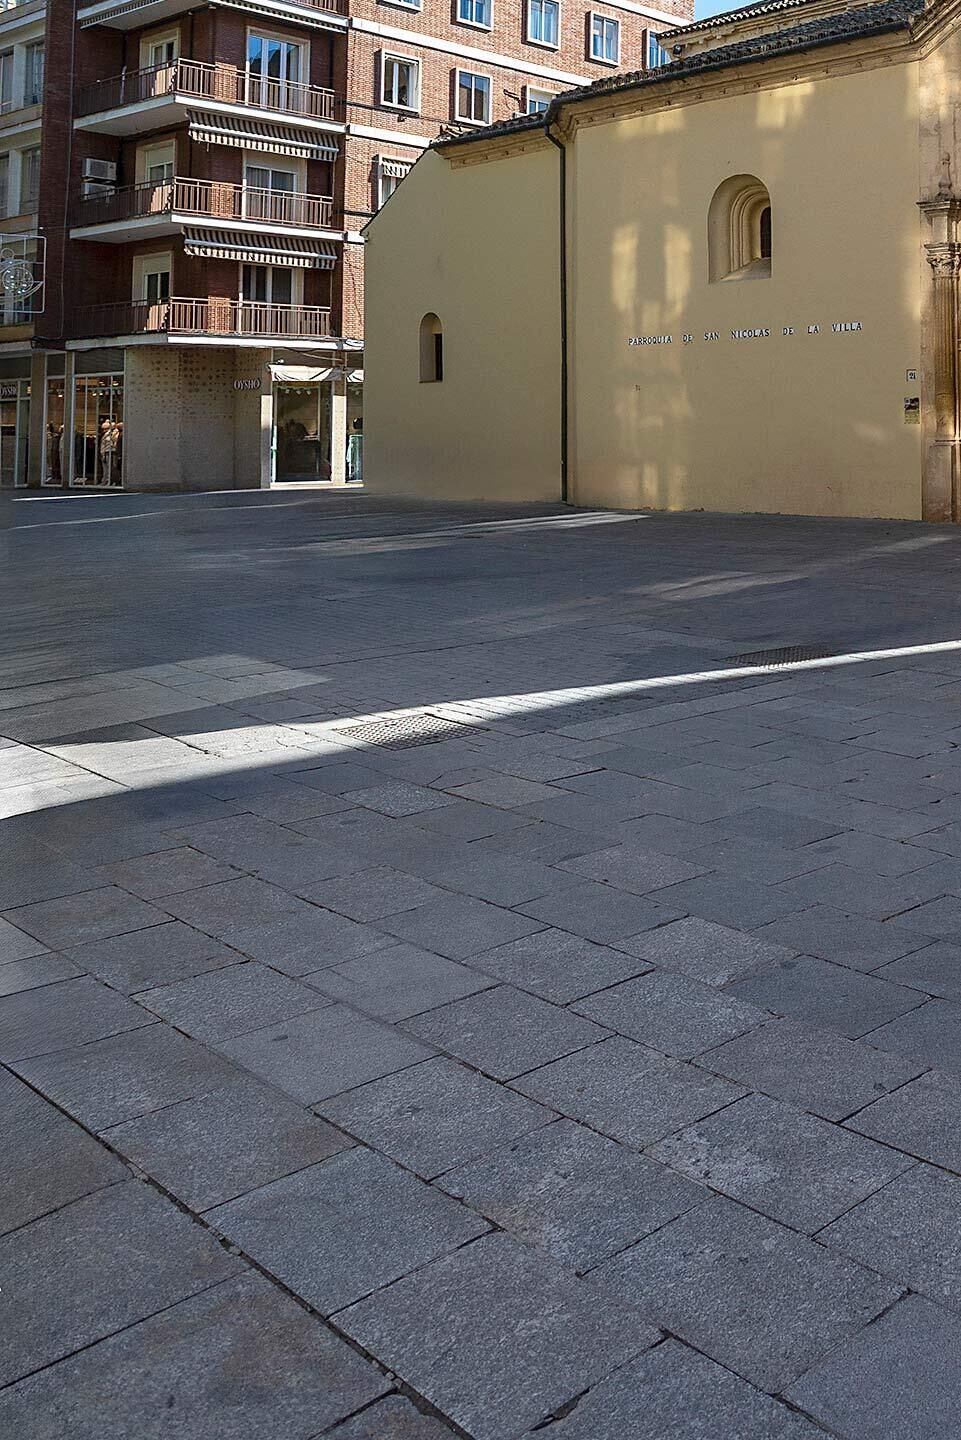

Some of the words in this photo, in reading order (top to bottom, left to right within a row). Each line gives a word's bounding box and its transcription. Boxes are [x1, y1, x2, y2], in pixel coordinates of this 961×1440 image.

[628, 335, 672, 346] PARROQUIA
[682, 334, 693, 343] DE
[704, 331, 720, 341] SAN
[731, 329, 770, 339] NICOLAS
[783, 327, 794, 336] DE
[807, 325, 819, 334] LA
[832, 322, 862, 332] VILLA
[233, 378, 260, 390] OYSHO
